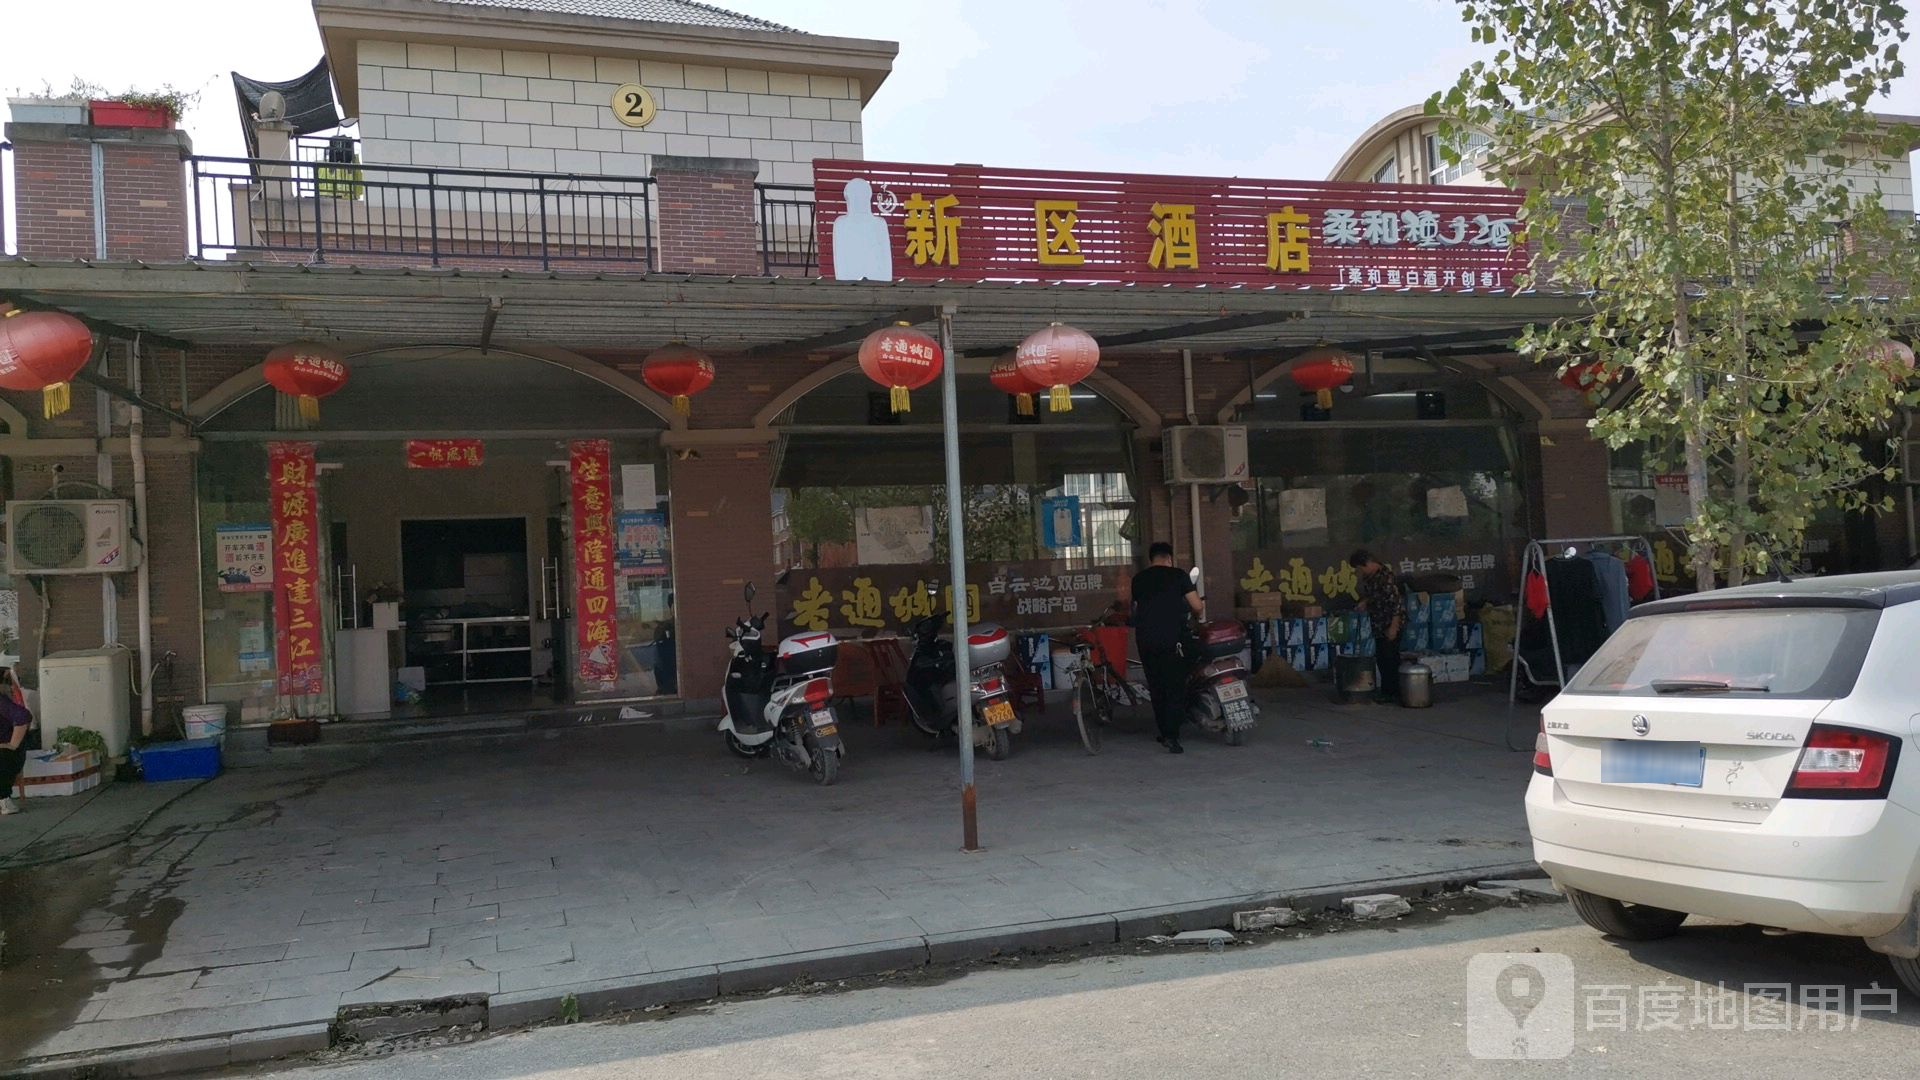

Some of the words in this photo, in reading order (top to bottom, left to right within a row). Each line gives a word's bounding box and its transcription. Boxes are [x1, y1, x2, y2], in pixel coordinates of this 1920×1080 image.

[625, 92, 644, 118] 2
[904, 192, 1311, 273] 新区酒店
[988, 574, 1104, 595] 白云边双品牌
[1016, 597, 1079, 615] 战略产品
[1745, 731, 1796, 742] SKODA
